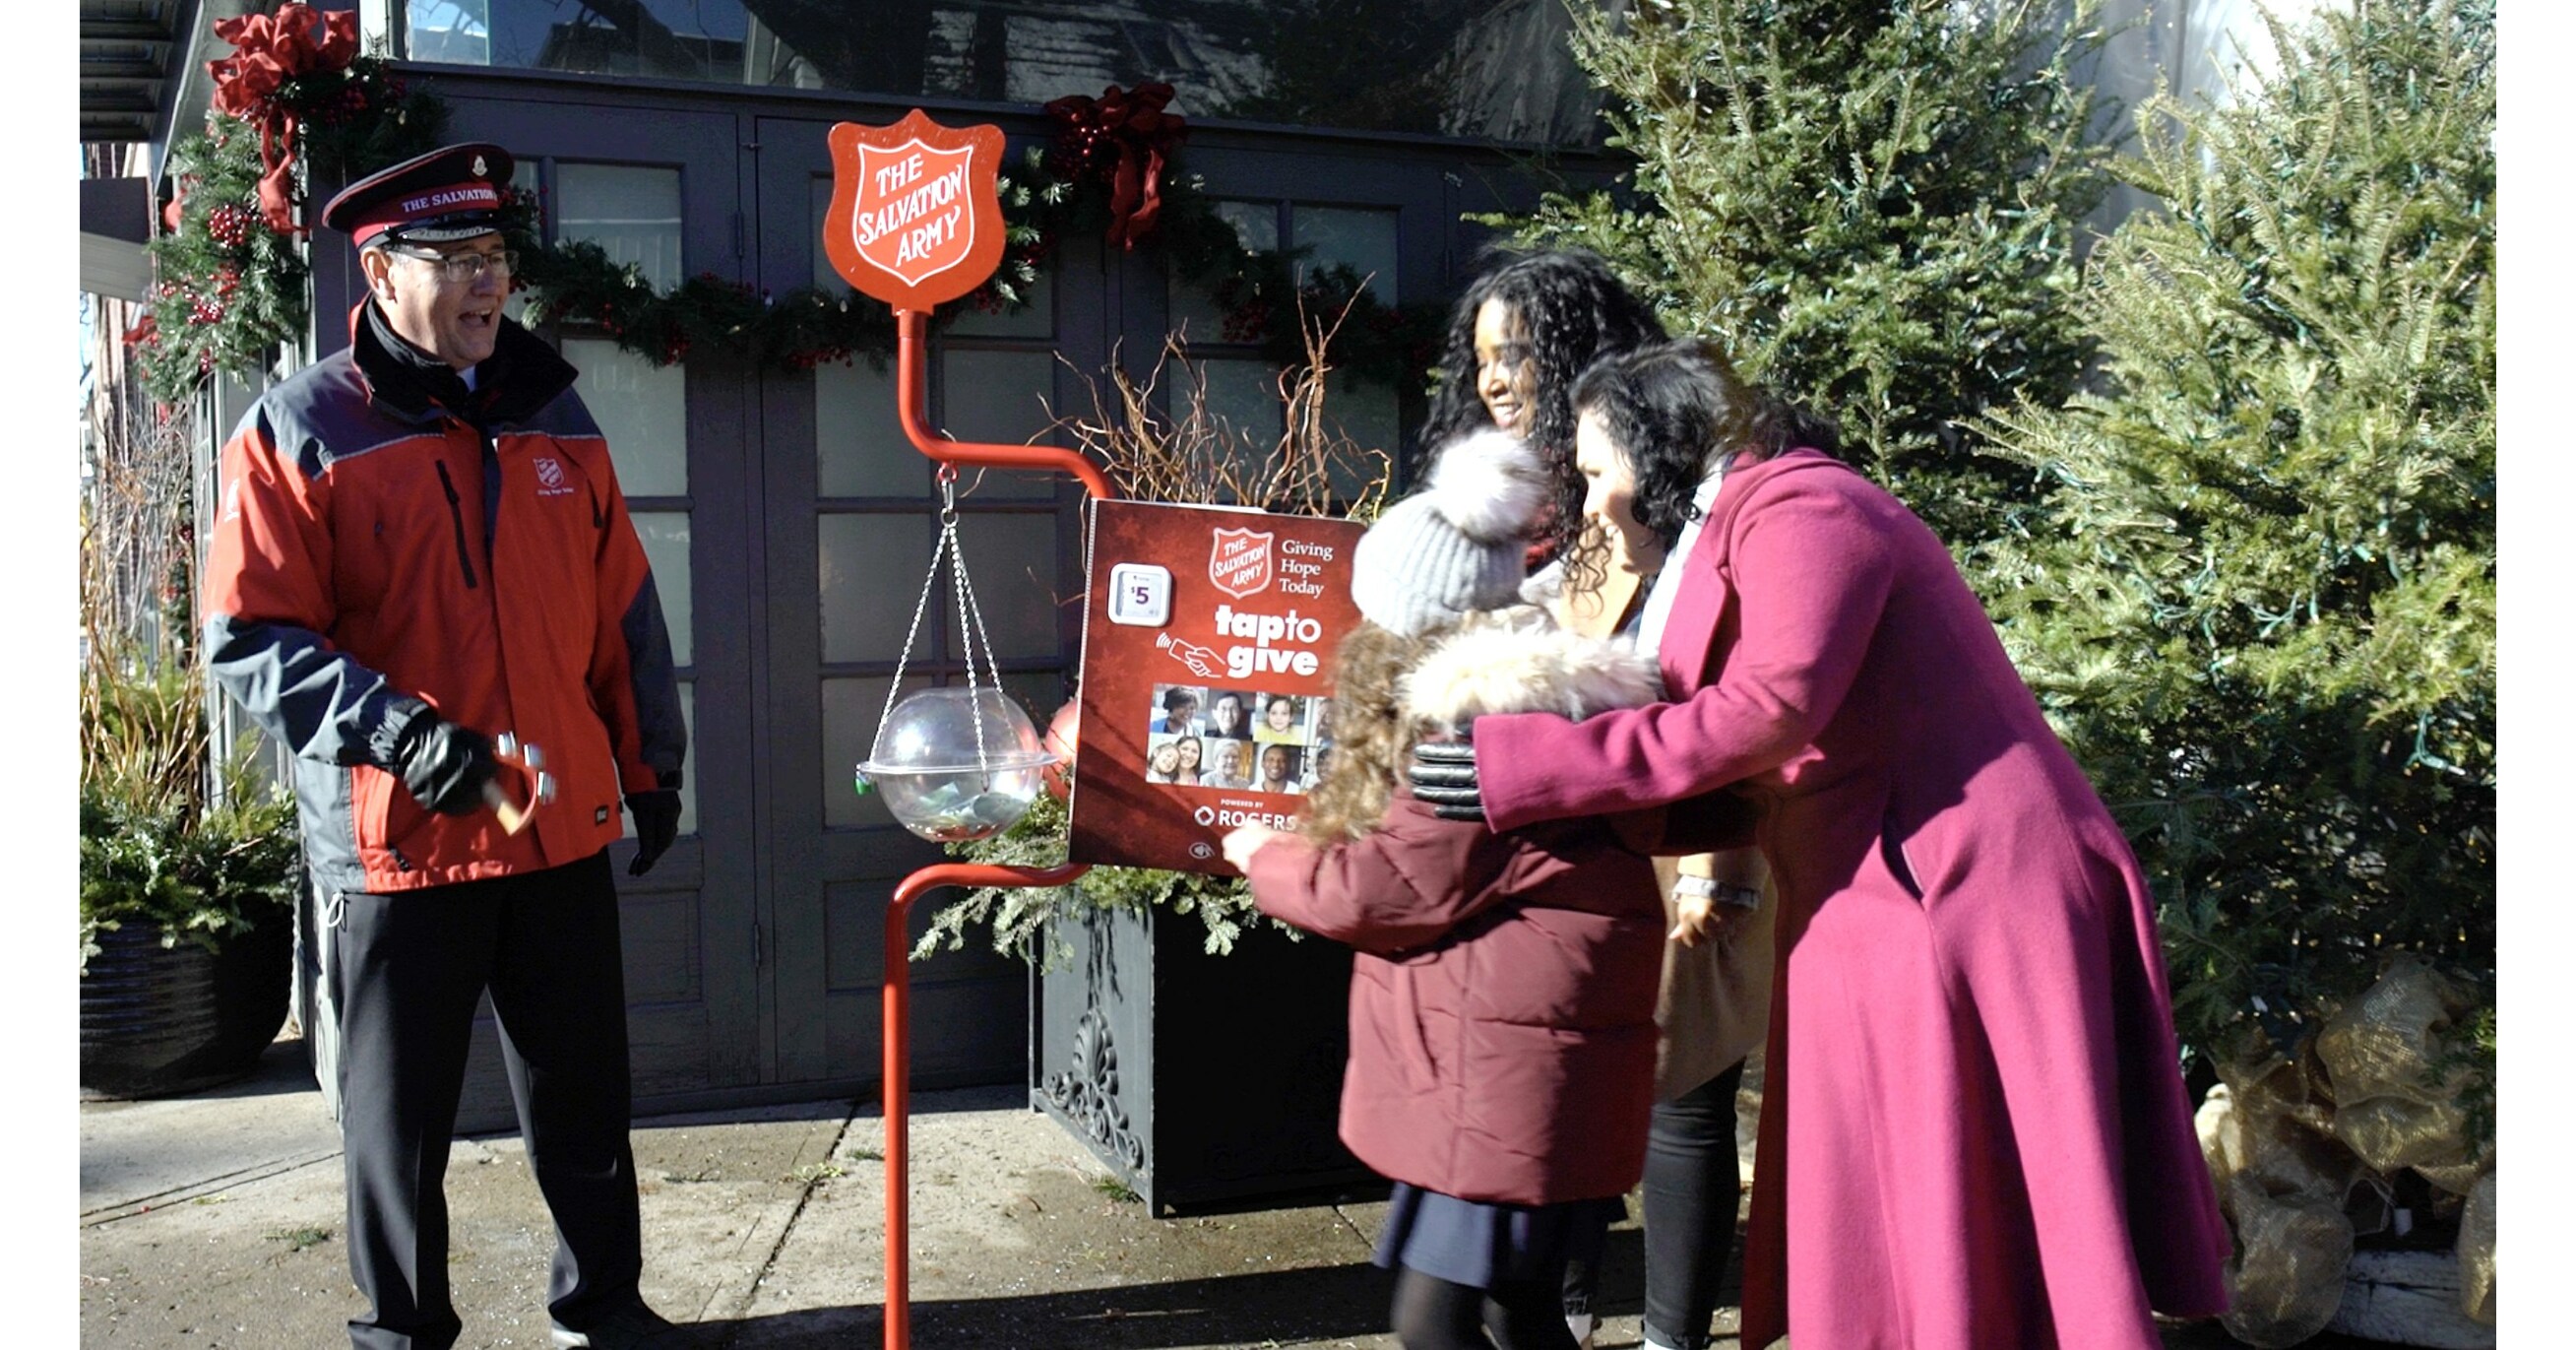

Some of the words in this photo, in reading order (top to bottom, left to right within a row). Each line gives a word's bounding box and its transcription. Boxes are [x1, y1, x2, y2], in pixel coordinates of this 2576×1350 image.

[876, 153, 923, 197] THE
[403, 198, 429, 212] THE
[858, 164, 963, 245] SALVATION
[896, 206, 961, 267] ARMY
[1224, 537, 1248, 557] THE
[1282, 539, 1334, 561] Giving
[1215, 544, 1266, 577] SALVATION
[1281, 558, 1321, 578] Hope
[1231, 562, 1264, 588] ARMY
[1279, 578, 1324, 599] Today
[1226, 645, 1319, 678] give
[1221, 799, 1253, 807] POWERED
